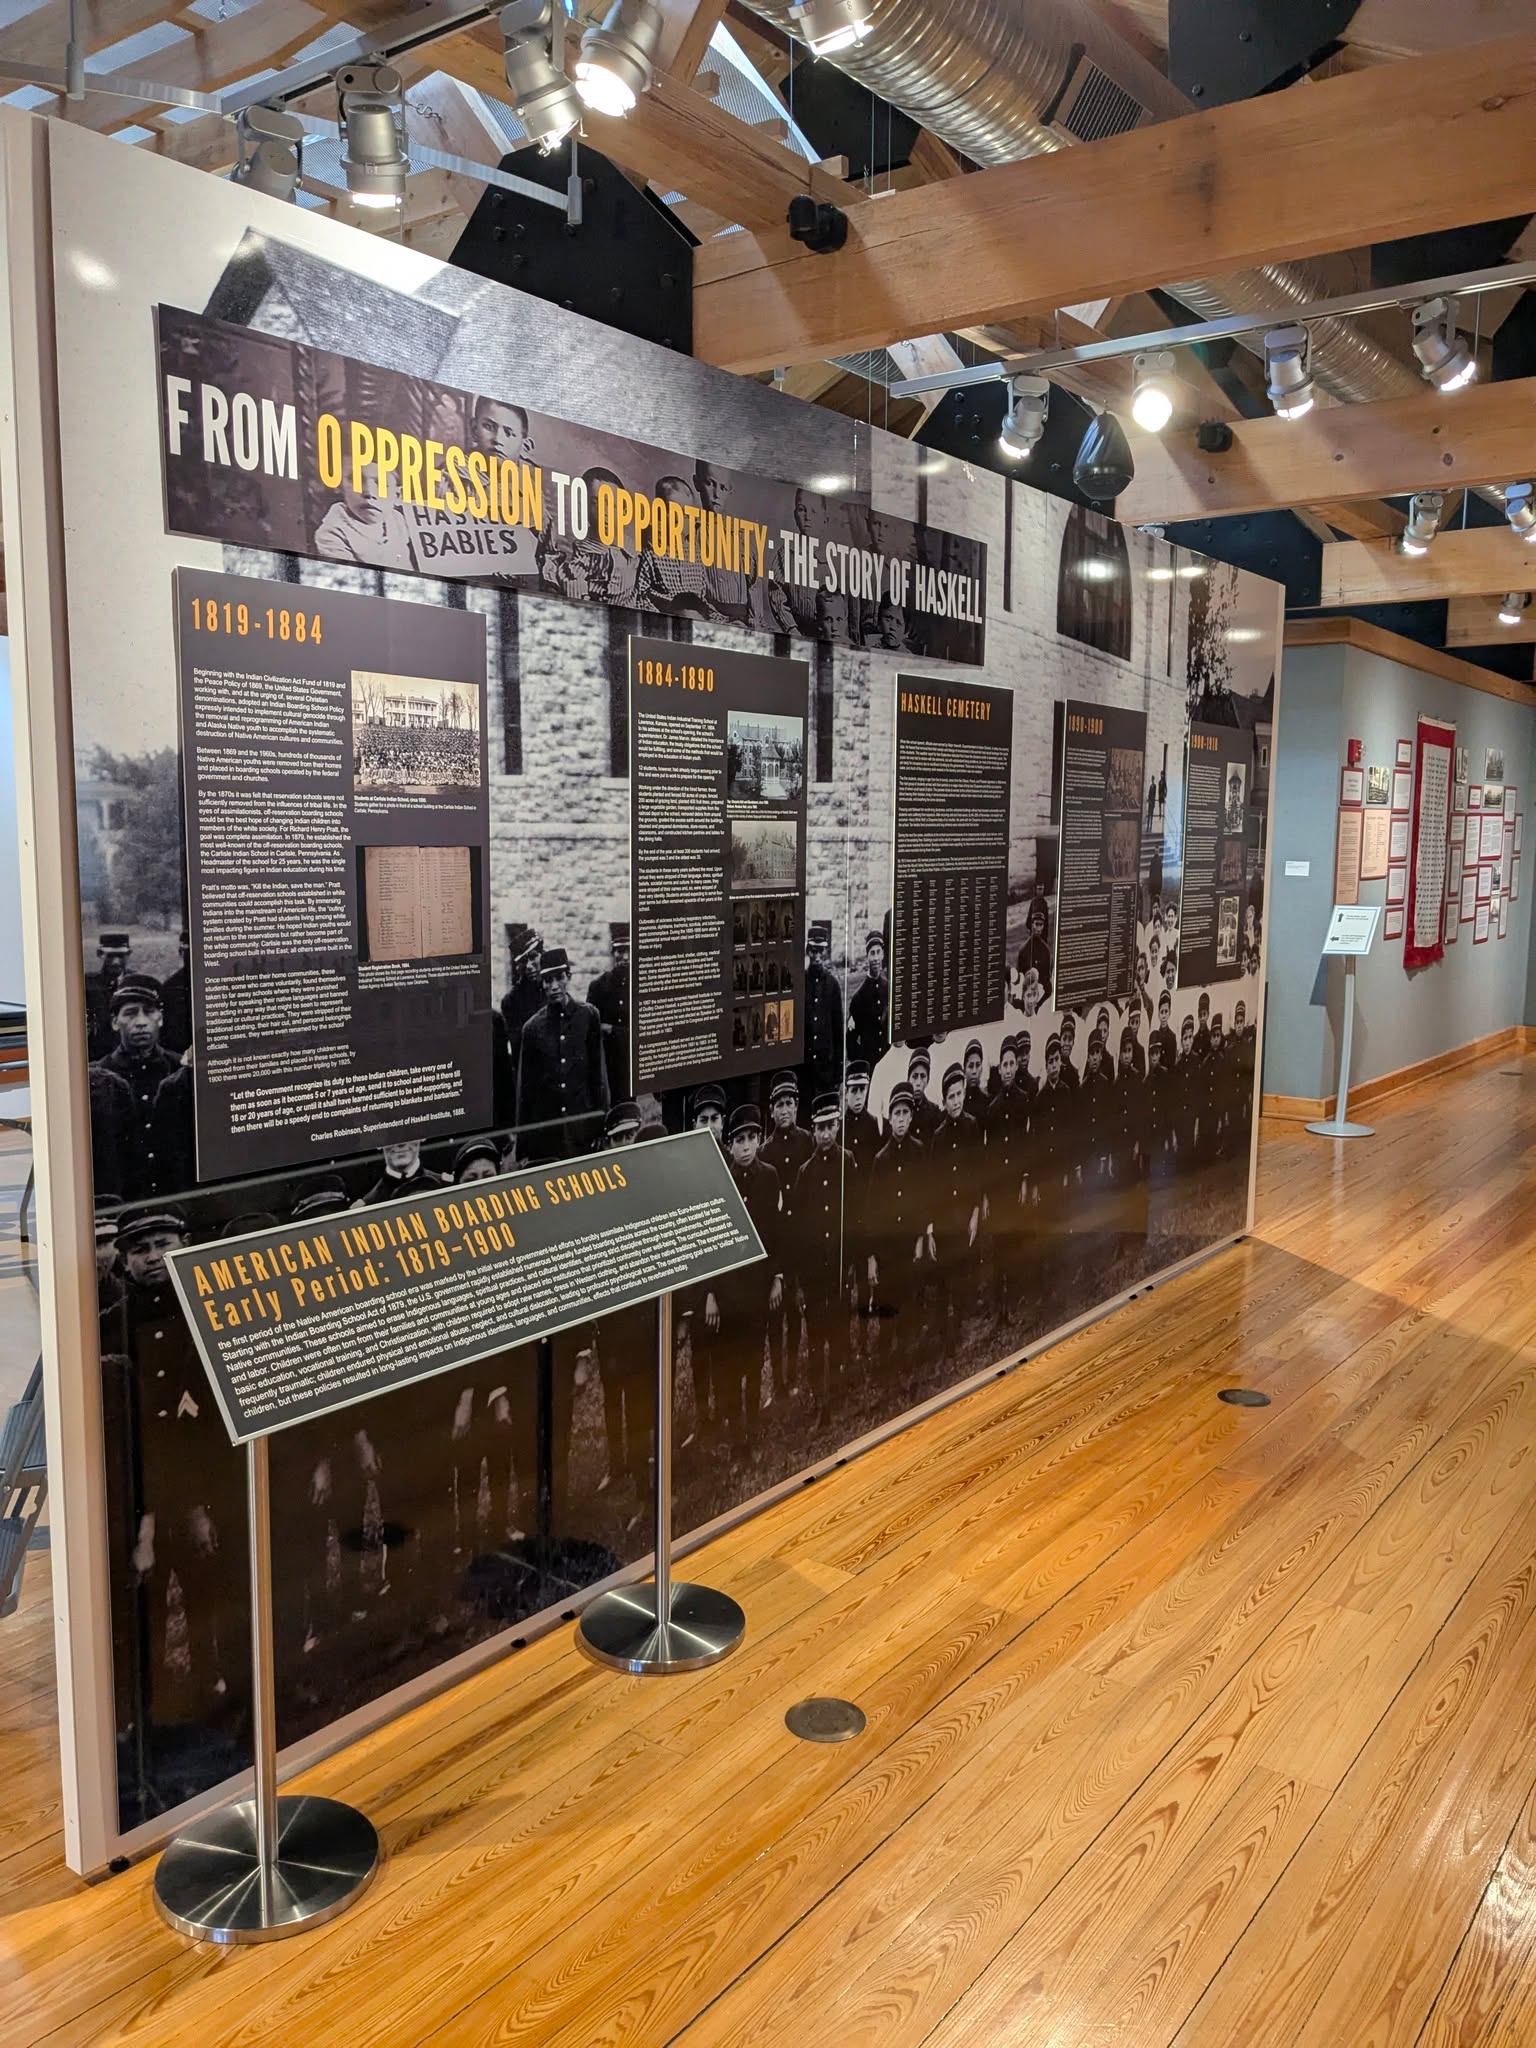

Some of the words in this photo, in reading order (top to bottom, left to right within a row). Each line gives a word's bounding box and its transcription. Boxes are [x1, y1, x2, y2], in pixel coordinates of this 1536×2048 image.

[167, 374, 298, 480] FROM
[317, 413, 543, 532] OPPRESSION
[551, 471, 588, 540] TO
[597, 484, 774, 580] OPPORTUNITY:
[779, 529, 819, 590] THE
[825, 541, 884, 602] STORY
[889, 557, 911, 608] OF
[915, 561, 983, 624] HASKELL
[418, 529, 518, 558] BABIES
[192, 597, 323, 645] 1819-1884
[637, 659, 715, 692] 1884-1890
[900, 692, 943, 716] HASKELL
[946, 696, 992, 721] CEMETERY
[193, 1235, 334, 1297] AMERICAN
[340, 1212, 428, 1258] INDIAN
[433, 1184, 541, 1234] BOARDING
[544, 1163, 627, 1205] SCHOOLS
[203, 1288, 282, 1331] Early
[290, 1258, 390, 1307] Period:
[217, 1339, 231, 1349] the
[231, 1334, 248, 1345] first
[248, 1326, 273, 1342] period
[273, 1324, 282, 1333] of
[282, 1321, 295, 1330] the
[295, 1314, 320, 1326] Native
[320, 1304, 354, 1319] American
[354, 1295, 385, 1310] boarding
[385, 1288, 407, 1300] school
[407, 1286, 419, 1294] era
[419, 1282, 433, 1290] was
[433, 1273, 457, 1286] marked
[456, 1271, 466, 1280] by
[465, 1268, 476, 1276] the
[476, 1263, 492, 1273] initial
[492, 1259, 508, 1268] wave
[508, 1256, 515, 1264] of
[515, 1244, 558, 1263] government-led
[557, 1240, 575, 1249] efforts
[221, 1345, 254, 1362] Starting
[253, 1340, 270, 1351] with
[270, 1336, 284, 1346] the
[284, 1329, 308, 1342] Indian
[308, 1319, 342, 1336] Boarding
[341, 1311, 366, 1324] School
[366, 1307, 379, 1317] Act
[378, 1304, 386, 1313] of
[387, 1299, 406, 1311] 1879,
[406, 1296, 418, 1305] the
[418, 1291, 433, 1301] U.S.
[433, 1280, 470, 1299] government
[470, 1274, 490, 1287] rapidly
[490, 1264, 523, 1280] established
[523, 1257, 551, 1270] numerous
[550, 1250, 574, 1262] federally
[573, 1244, 592, 1255] funded
[591, 1238, 615, 1250] boarding
[614, 1232, 633, 1243] schools
[225, 1358, 252, 1372] Native
[252, 1343, 302, 1364] communities.
[302, 1335, 327, 1348] These
[327, 1326, 355, 1341] schools
[355, 1319, 377, 1332] aimed
[377, 1317, 385, 1325] to
[385, 1312, 405, 1323] erase
[405, 1300, 441, 1318] Indigenous
[440, 1290, 475, 1307] languages,
[474, 1282, 499, 1296] spiritual
[526, 1270, 538, 1280] and
[537, 1264, 558, 1276] cultural
[583, 1250, 608, 1263] enforcing
[242, 1401, 277, 1418] children,
[277, 1395, 291, 1406] but
[291, 1388, 313, 1401] these
[313, 1379, 342, 1396] policies
[341, 1368, 370, 1384] resulted
[370, 1366, 378, 1374] in
[378, 1353, 418, 1373] long-lasting
[417, 1345, 443, 1359] impacts
[443, 1342, 453, 1350] on
[452, 1330, 487, 1347] Indigenous
[546, 1305, 558, 1315] and
